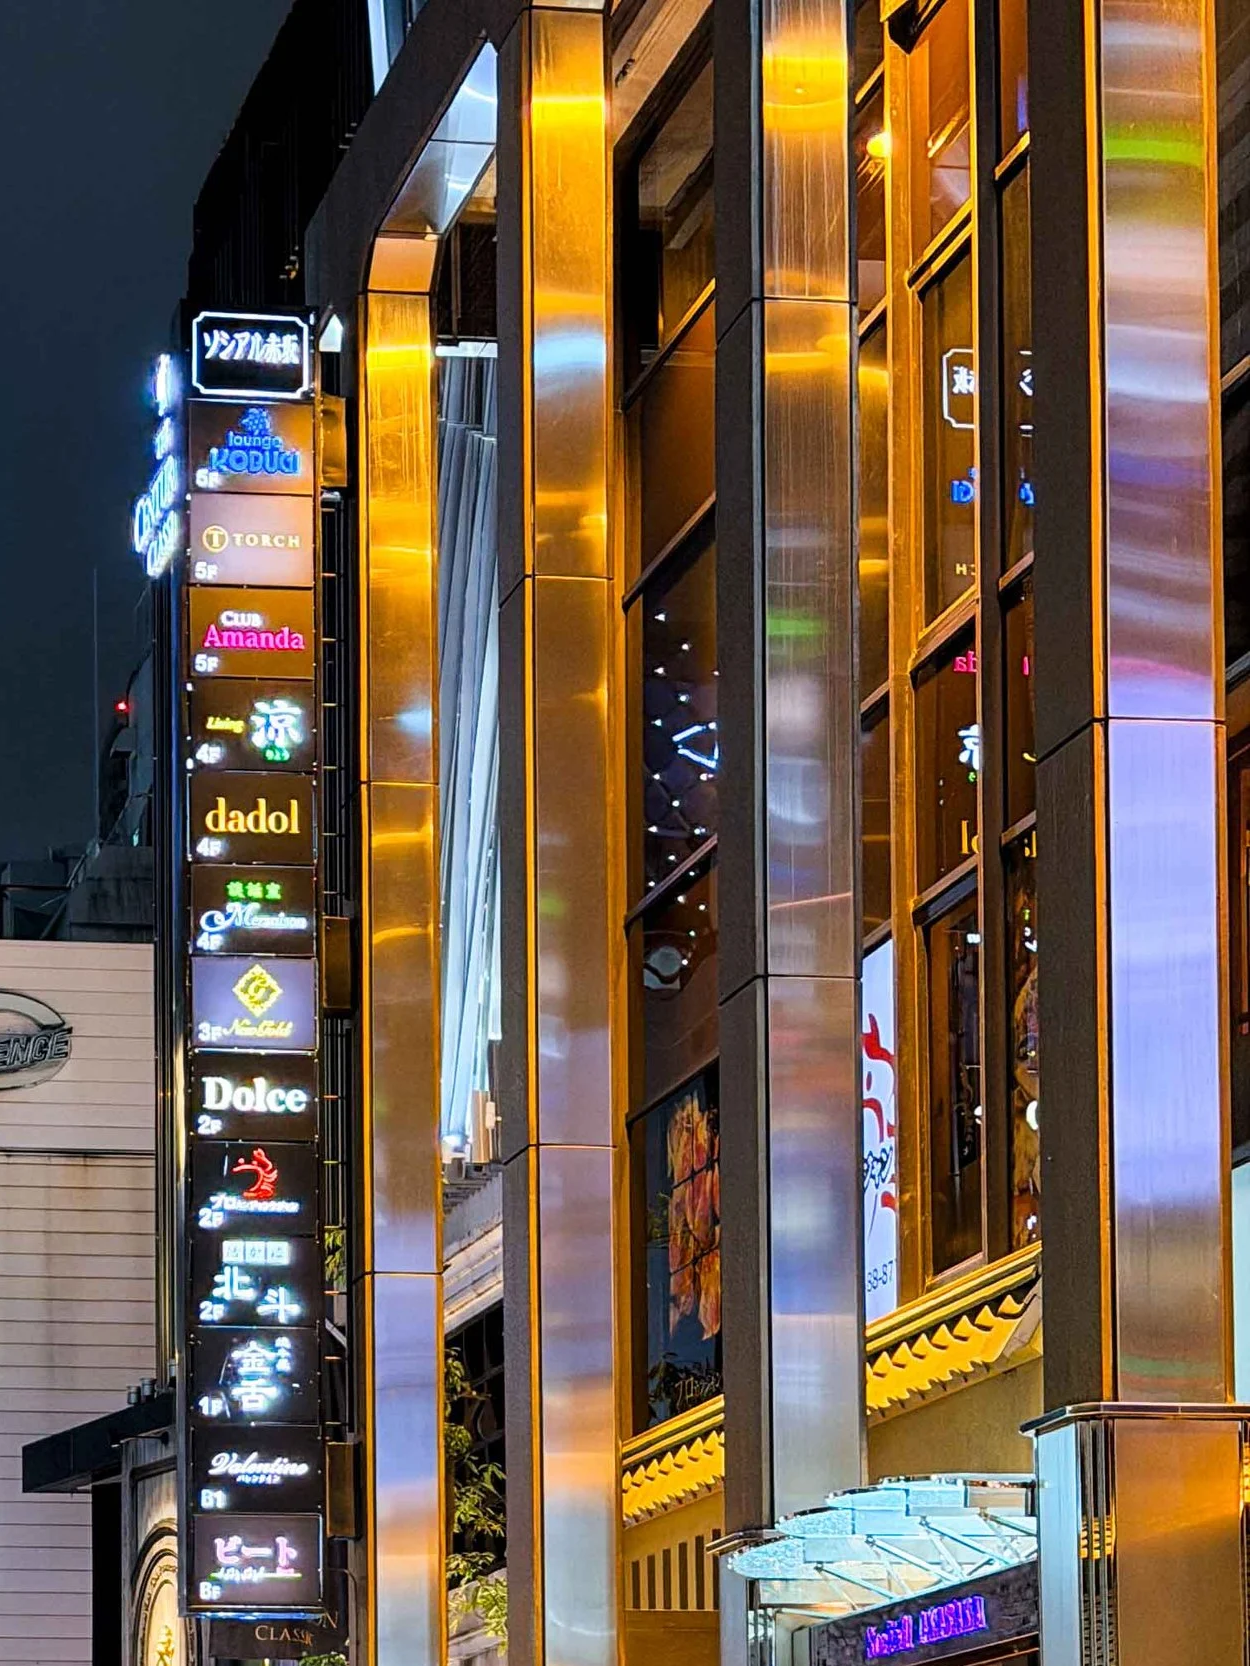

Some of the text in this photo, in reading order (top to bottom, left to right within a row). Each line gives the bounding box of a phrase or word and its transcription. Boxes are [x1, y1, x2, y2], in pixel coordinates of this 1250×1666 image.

[227, 431, 283, 449] lounge
[233, 533, 300, 547] TORCH
[204, 624, 305, 650] Amanda
[195, 654, 219, 672] 5F
[205, 797, 300, 834] dadol
[202, 1076, 308, 1113] Dolce
[208, 1451, 310, 1476] Valentine
[201, 1488, 227, 1509] B1
[214, 1534, 299, 1566] ビート
